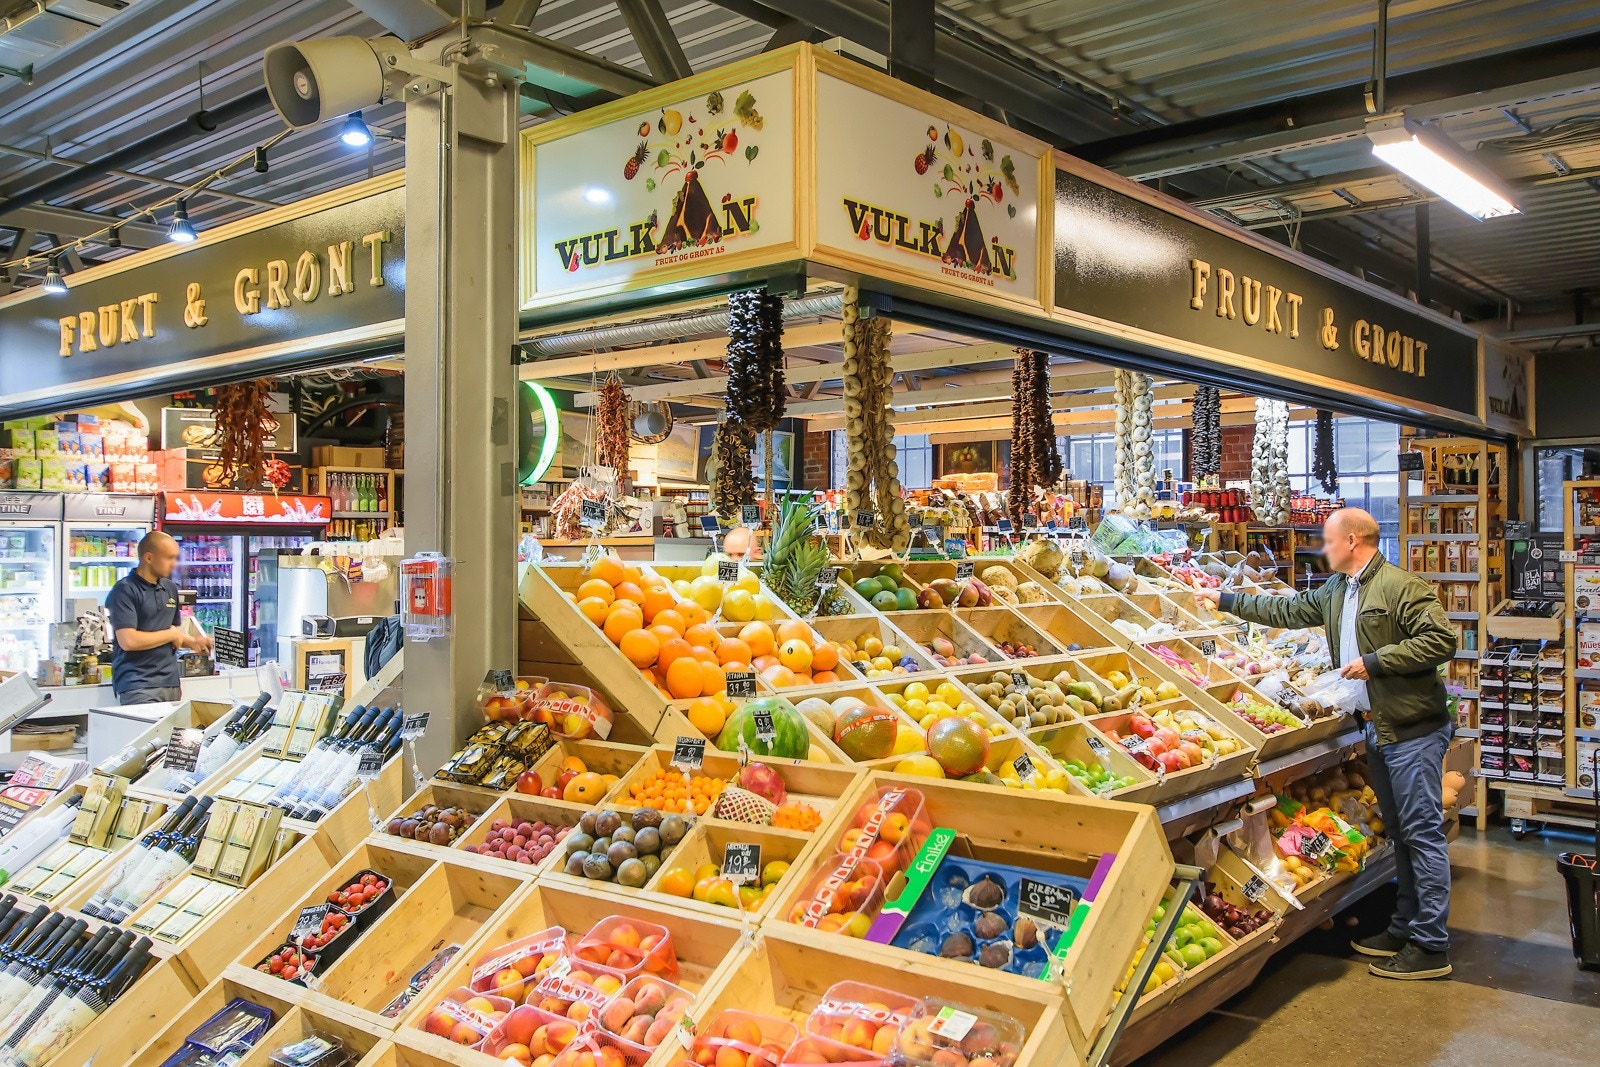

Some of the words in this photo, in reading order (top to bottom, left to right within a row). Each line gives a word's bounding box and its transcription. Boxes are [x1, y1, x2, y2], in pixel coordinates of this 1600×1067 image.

[555, 179, 756, 272] VULKAN
[843, 198, 1015, 278] VULKAN
[655, 256, 678, 266] FRUKT
[679, 253, 688, 261] OG
[715, 245, 725, 253] AS
[941, 266, 960, 278] FRUKT
[960, 271, 968, 280] OG
[987, 279, 995, 287] AS
[58, 292, 158, 357] FRUKT
[183, 282, 208, 328] &
[234, 230, 391, 315] GRØNT
[1191, 258, 1303, 339] FRUKT
[1321, 307, 1339, 350] &
[1354, 318, 1428, 377] GRØNT
[0, 505, 28, 513] TINE
[97, 507, 123, 515] TINE
[729, 682, 740, 696] 39
[6, 785, 39, 805] VG
[727, 855, 742, 873] 19
[916, 833, 950, 874] finike
[1029, 892, 1041, 912] 9
